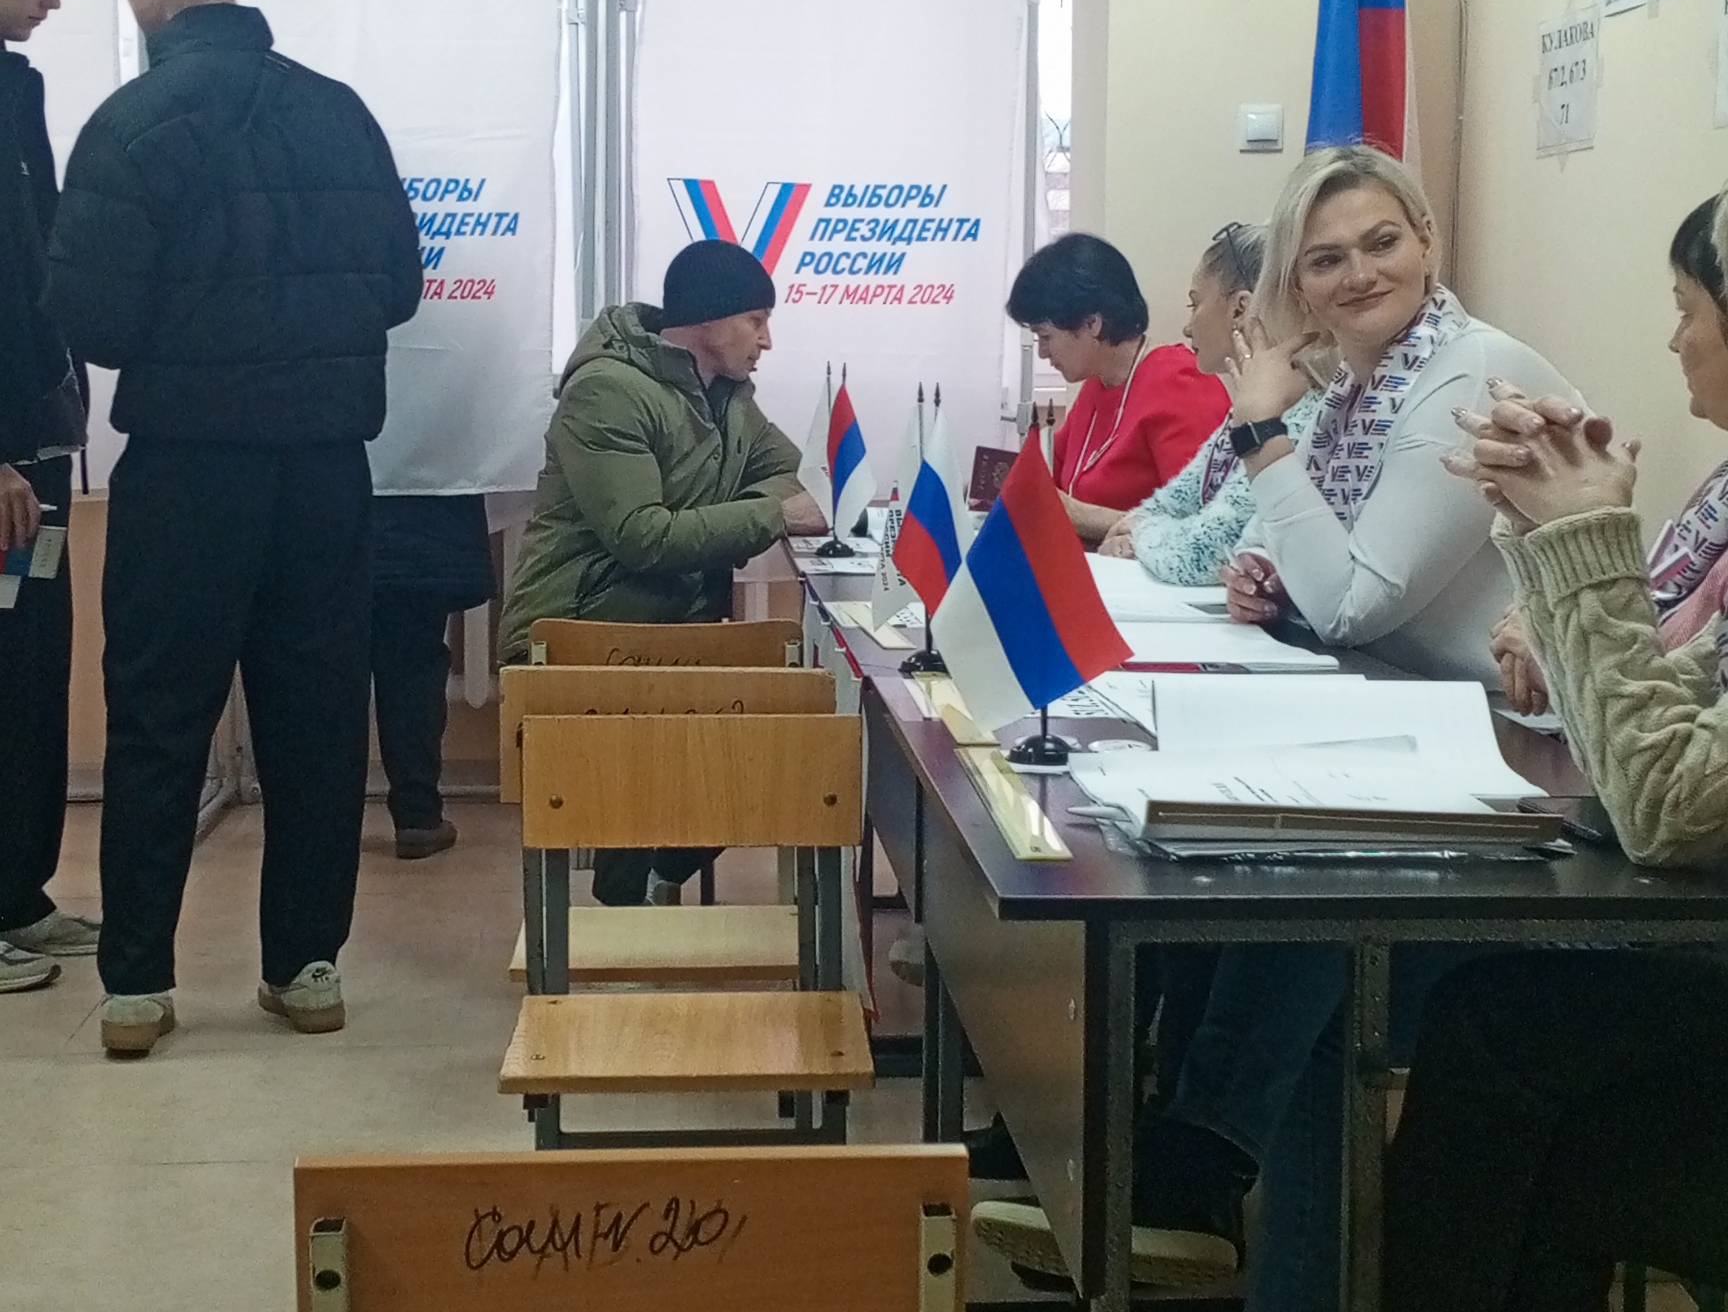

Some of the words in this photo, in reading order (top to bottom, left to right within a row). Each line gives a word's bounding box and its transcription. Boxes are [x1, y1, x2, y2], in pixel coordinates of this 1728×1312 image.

[400, 177, 486, 202] БОРЫ
[823, 184, 947, 209] ВЫБОРЫ
[412, 212, 520, 240] ИДЕНТА
[809, 218, 981, 245] ПРЕЗИДЕНТА
[795, 251, 907, 276] РОССИИ
[447, 278, 496, 300] 2024
[839, 284, 903, 305] МАРТА
[908, 283, 955, 305] 2024
